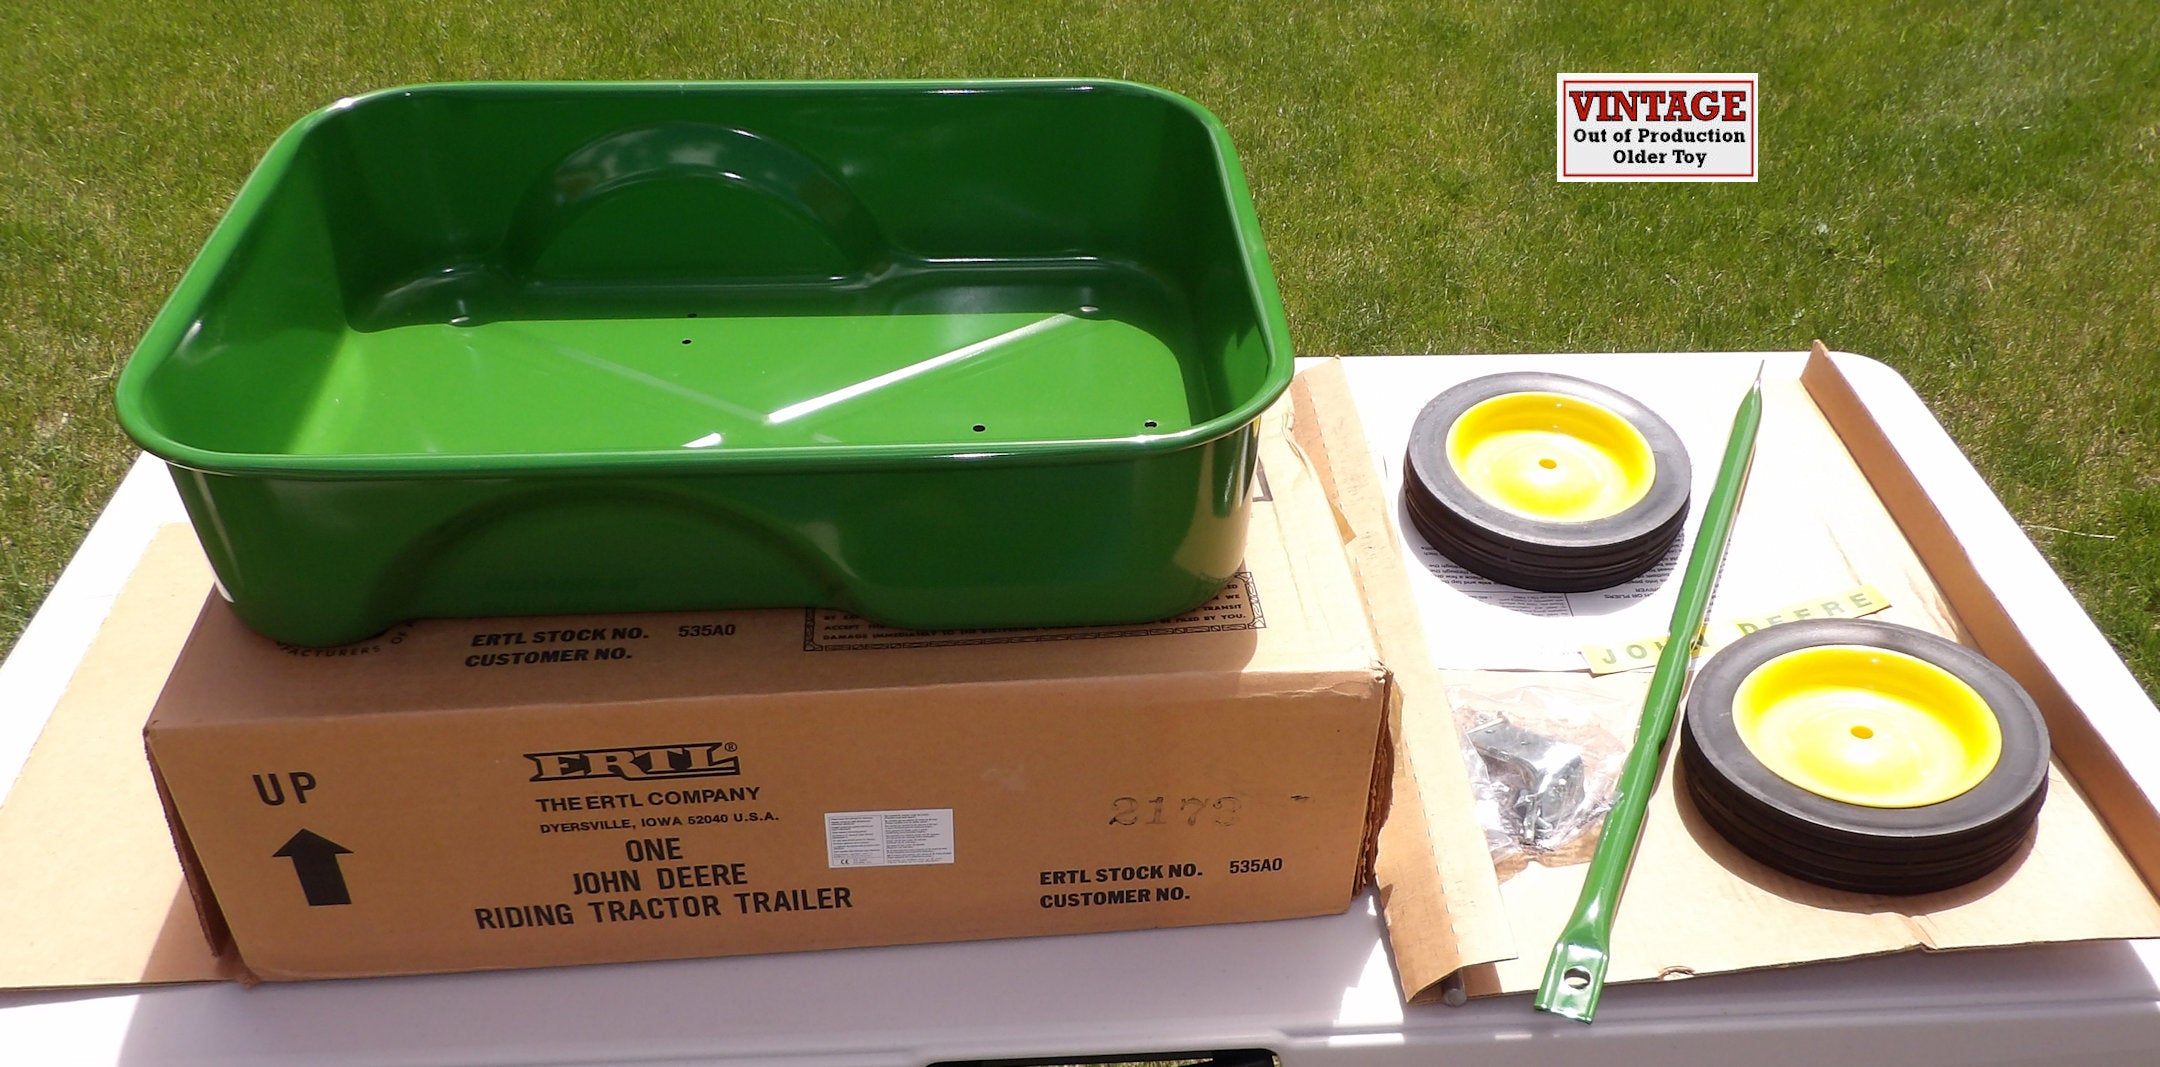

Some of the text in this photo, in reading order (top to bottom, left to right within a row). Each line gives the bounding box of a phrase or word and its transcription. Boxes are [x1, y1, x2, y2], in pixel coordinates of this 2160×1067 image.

[471, 626, 650, 648] ERTL STOCK NO.
[464, 646, 633, 669] CUSTOMER NO.
[253, 771, 319, 807] UP
[535, 785, 761, 814] THE ERTL COMPANY
[539, 810, 780, 835] DYERSVILLE, IOWA 52040 U.S.A.
[625, 836, 684, 863] ONE
[573, 863, 748, 896] JOHN DEERE
[1040, 861, 1204, 886] ERTL STOCK NO.
[475, 886, 853, 930] RIDING TRACTOR TRAILER
[1039, 885, 1191, 909] CUSTOMER NO.
